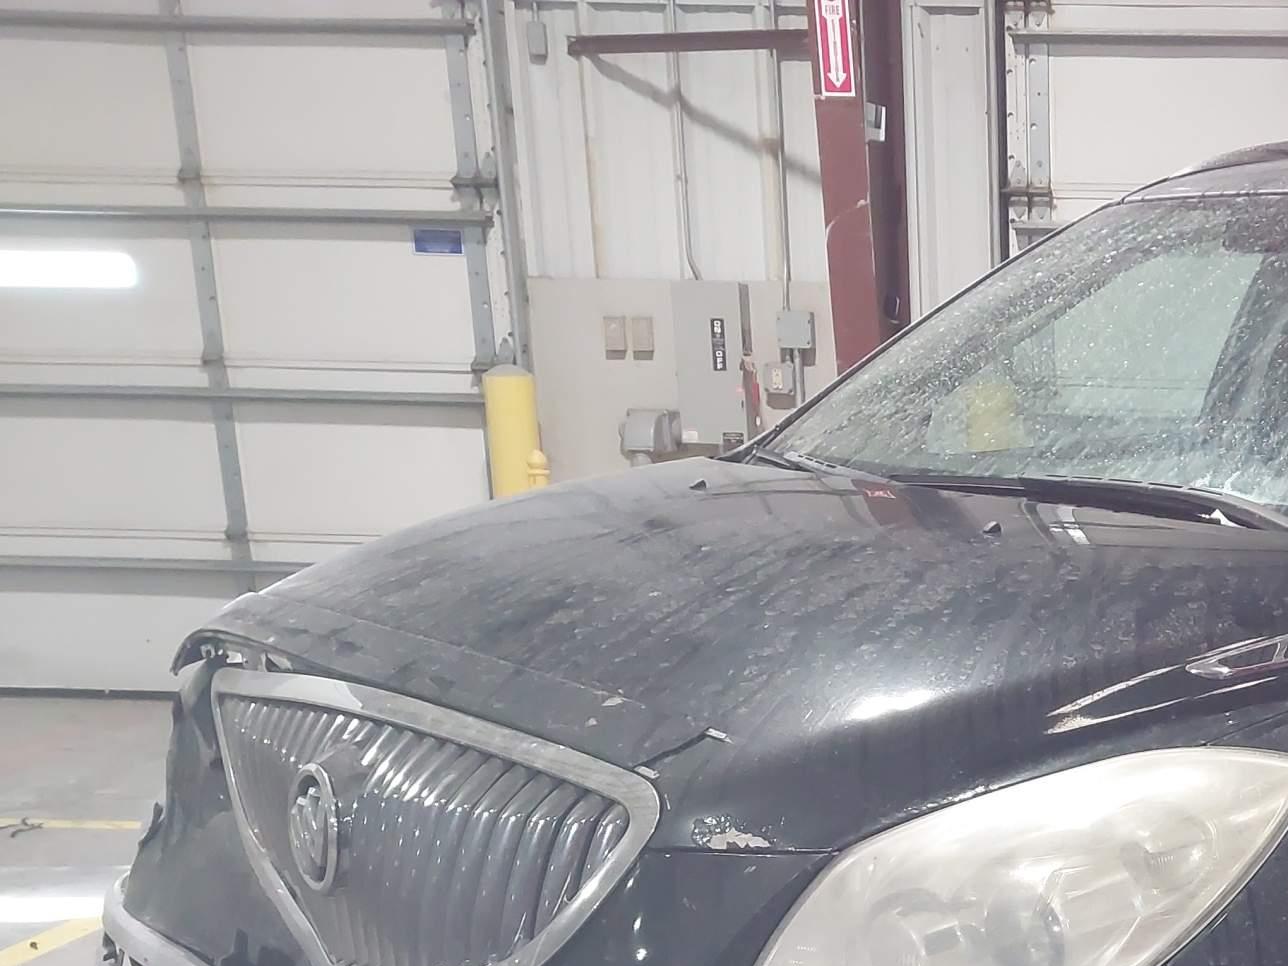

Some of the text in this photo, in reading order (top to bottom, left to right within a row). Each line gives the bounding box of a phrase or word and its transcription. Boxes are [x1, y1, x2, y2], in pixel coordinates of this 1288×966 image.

[825, 4, 840, 15] FIRE
[713, 320, 721, 333] ON
[715, 350, 723, 369] OFF
